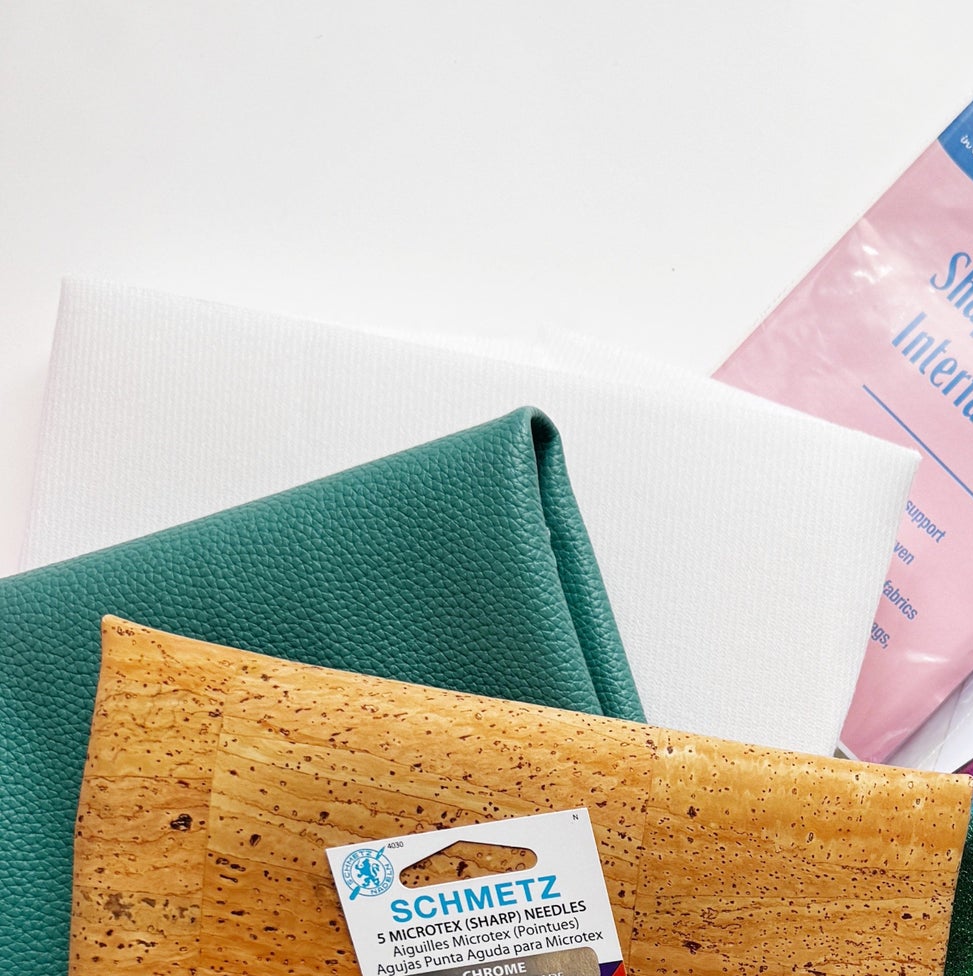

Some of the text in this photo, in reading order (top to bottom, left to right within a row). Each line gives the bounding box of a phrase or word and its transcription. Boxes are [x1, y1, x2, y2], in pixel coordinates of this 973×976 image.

[960, 135, 972, 150] in
[905, 500, 946, 544] support
[387, 841, 404, 849] 4030
[390, 875, 561, 923] SCHMETZ
[377, 900, 587, 945] 5 MICROTEX (SHARP) NEEDLES
[393, 916, 580, 958] Aiguilles Microtex (Pointues)
[377, 929, 604, 976] Agujas Punta Aguda para Microtex
